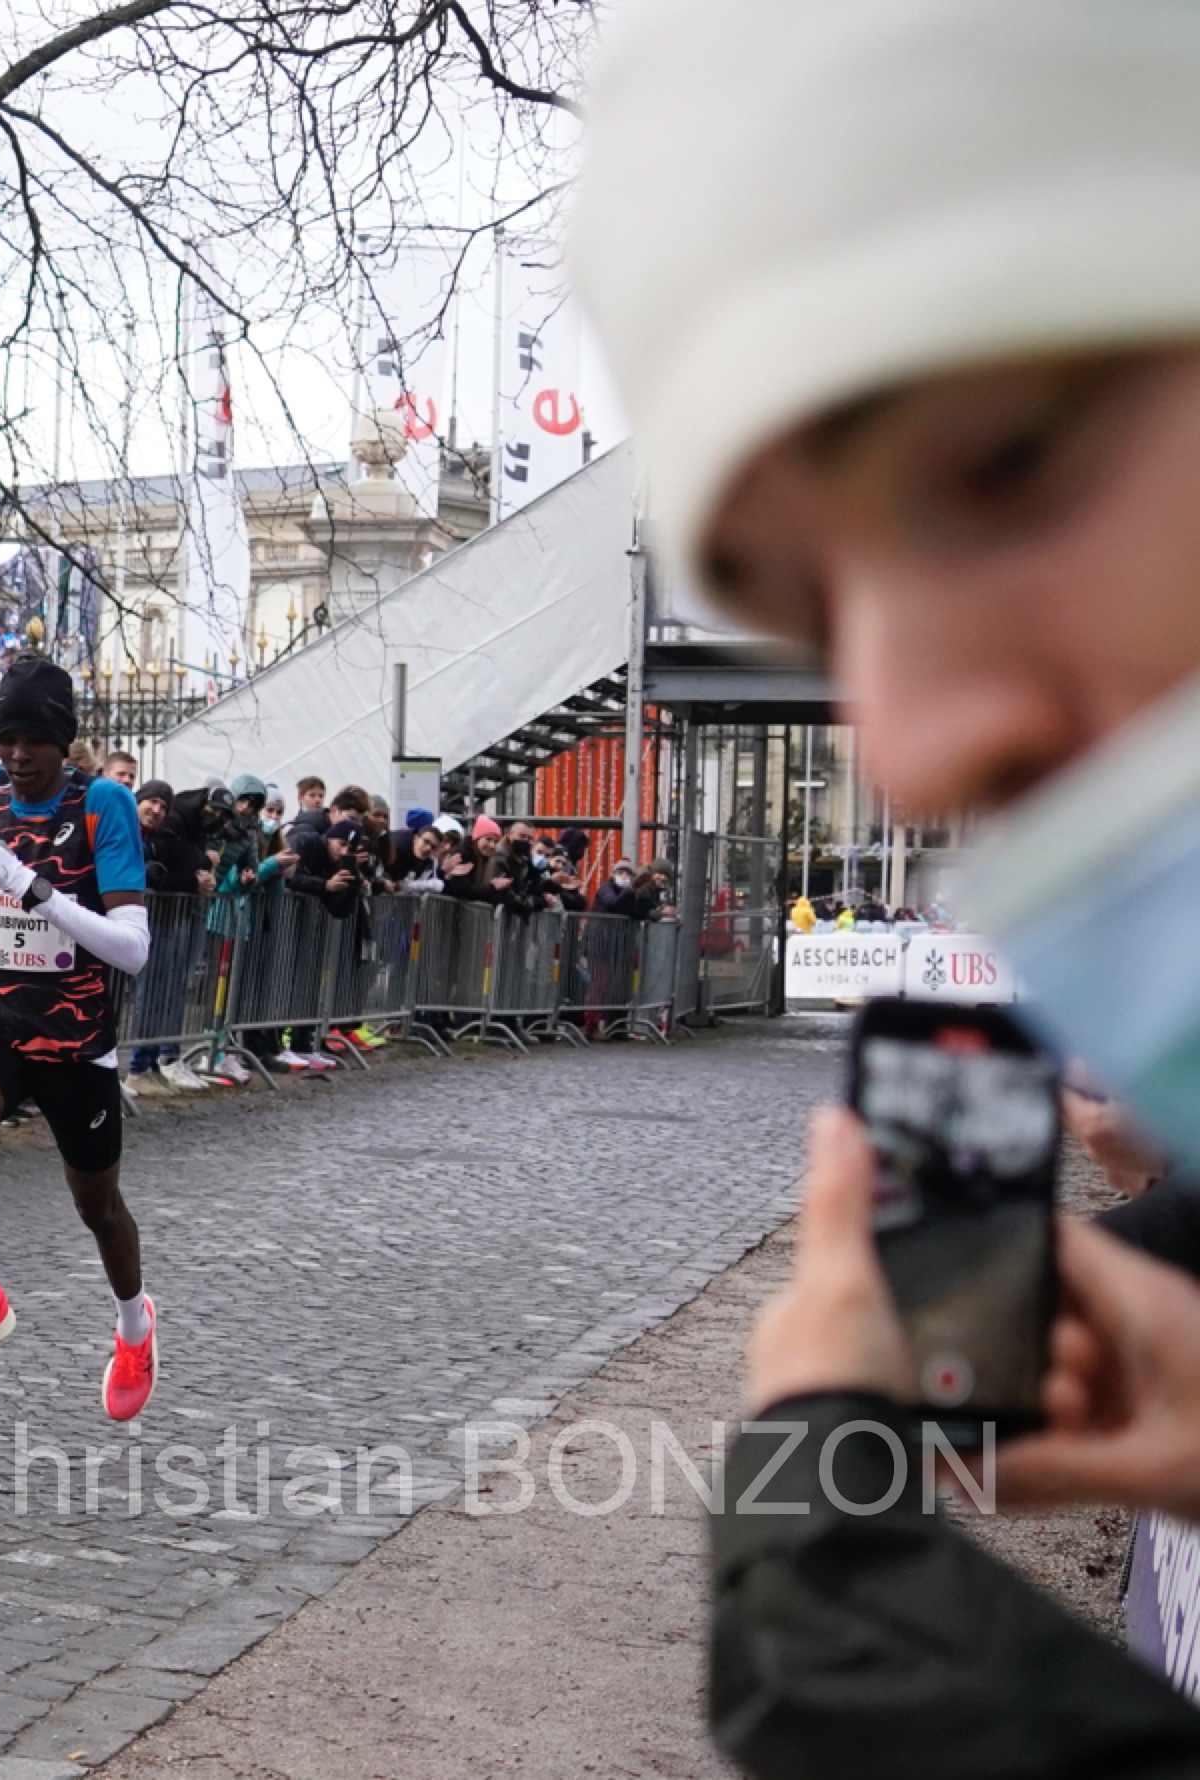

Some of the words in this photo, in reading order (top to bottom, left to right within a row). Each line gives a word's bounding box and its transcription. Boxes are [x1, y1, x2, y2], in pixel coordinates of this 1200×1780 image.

[13, 932, 25, 948] 5
[13, 952, 47, 967] UBS
[791, 948, 897, 967] AESCHBACH
[951, 953, 998, 985] UBS
